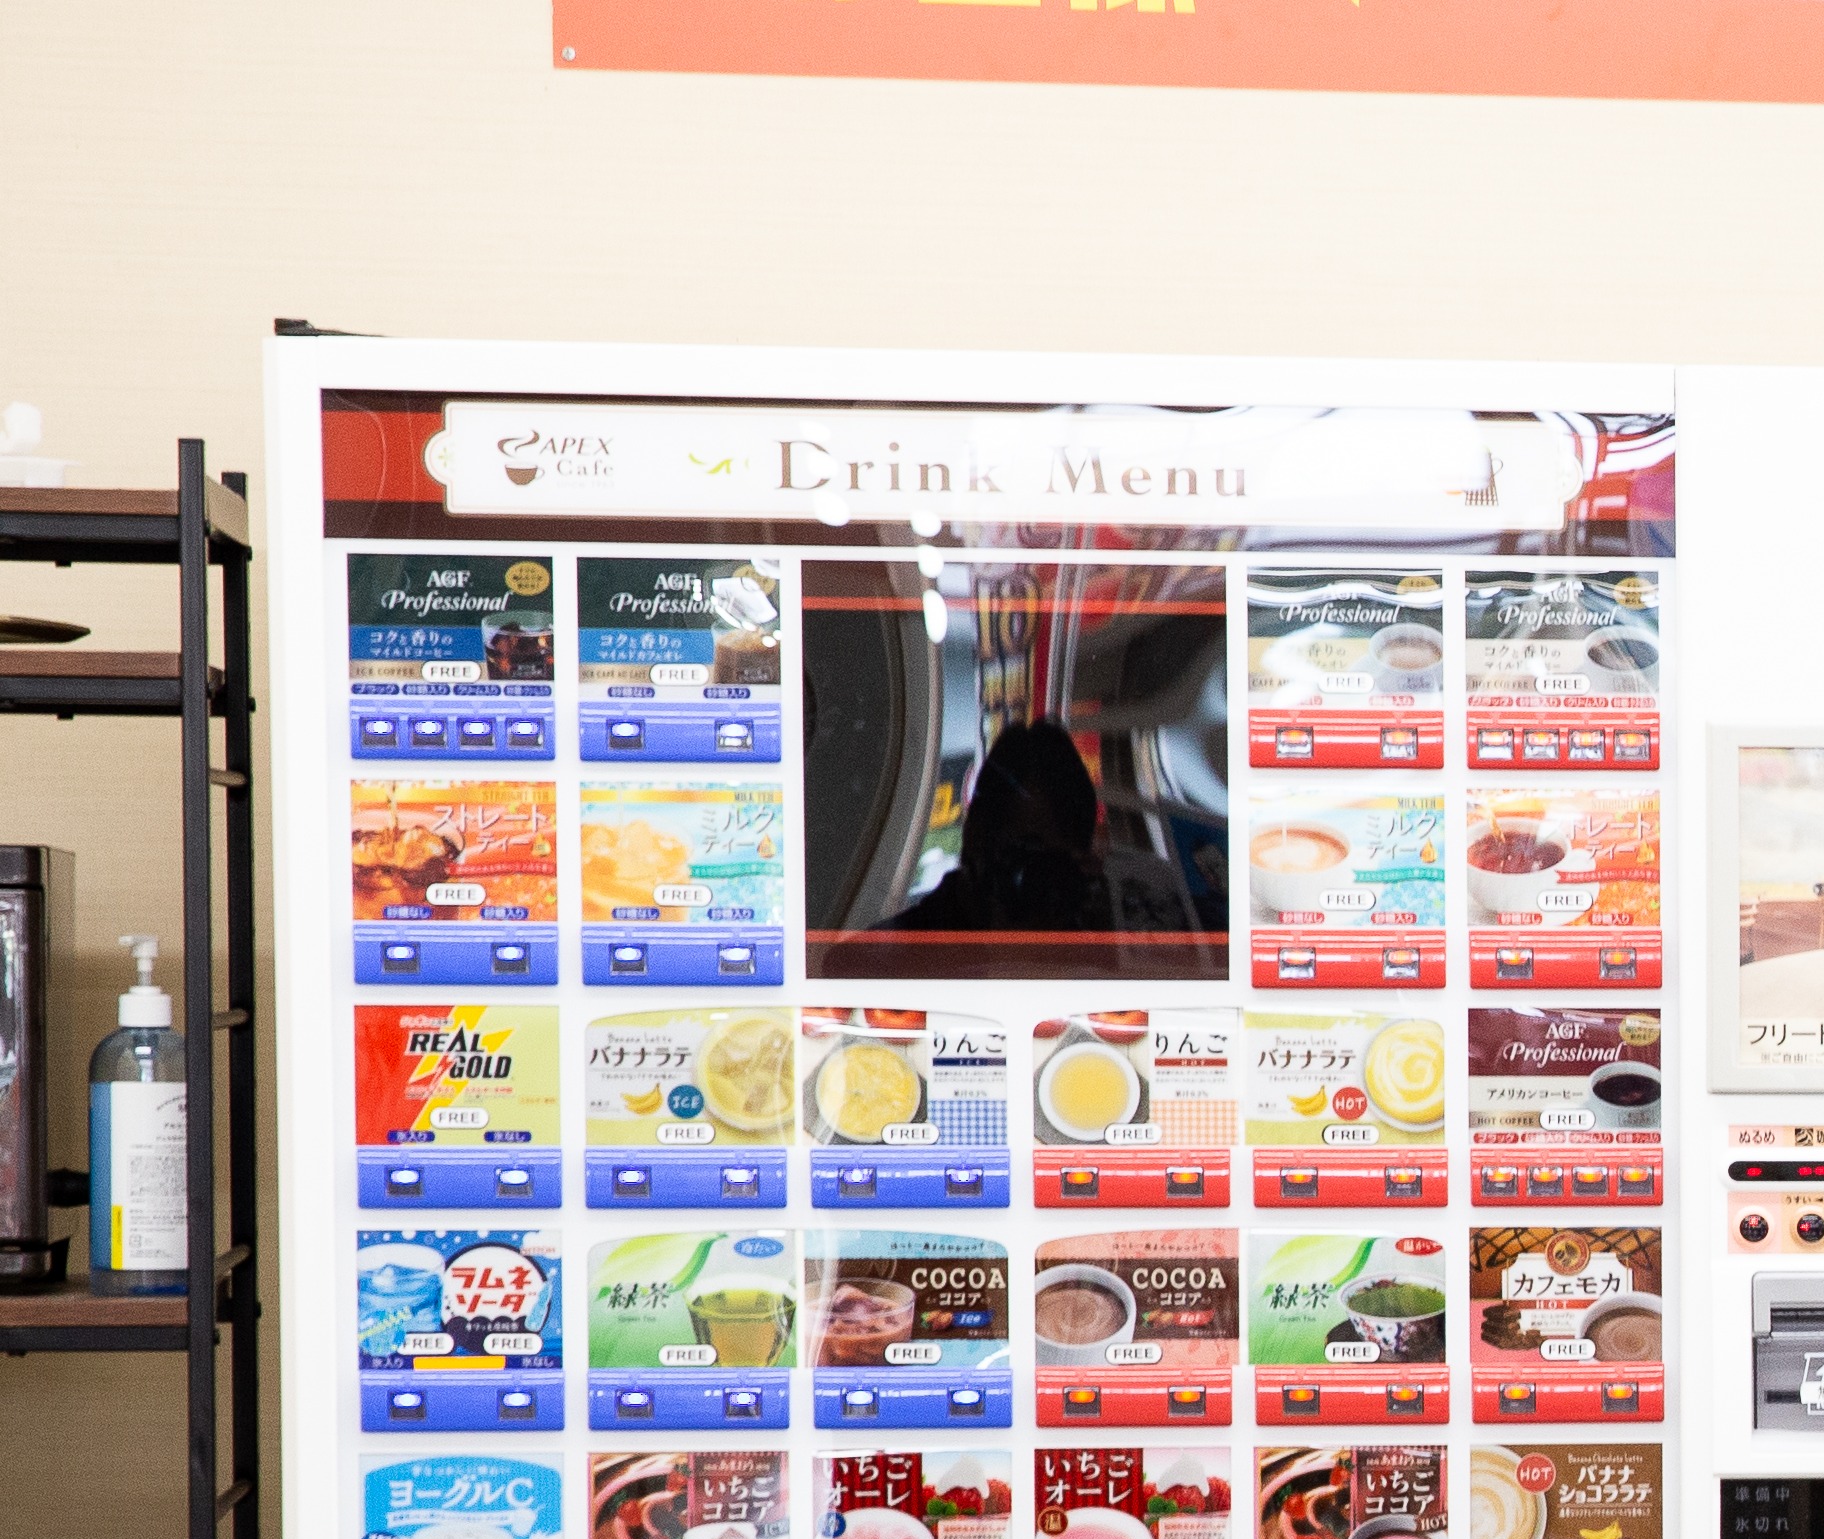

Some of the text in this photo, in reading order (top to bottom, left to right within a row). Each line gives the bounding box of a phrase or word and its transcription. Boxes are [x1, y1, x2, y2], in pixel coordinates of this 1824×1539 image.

[1046, 444, 1247, 497] Menu
[427, 570, 470, 589] AGF
[382, 589, 511, 615] Professional
[430, 665, 472, 679] FREE
[1326, 677, 1367, 689] FREE
[1545, 894, 1585, 907] FREE
[408, 1025, 486, 1055] REAL
[1545, 1021, 1587, 1040] AGF
[1154, 1031, 1230, 1055] りんご
[1503, 1040, 1622, 1068] Professional
[450, 1054, 513, 1080] GOLD
[589, 1046, 693, 1068] バナナラテ
[1257, 1048, 1357, 1069] バナナラテ
[1335, 1097, 1365, 1111] HOT
[1739, 1129, 1776, 1145] ぬるめ
[451, 1266, 533, 1290] ラムネ
[911, 1267, 1007, 1291] COCOA
[1131, 1267, 1227, 1291] COCOA
[1513, 1272, 1621, 1298] カフェモカ
[456, 1291, 538, 1314] ソーダ
[608, 1282, 671, 1312] 緑茶
[1270, 1282, 1329, 1311] 緑茶
[492, 1337, 534, 1350] FREE
[1043, 1452, 1134, 1480] いちご
[1520, 1467, 1552, 1482] HOT
[1578, 1465, 1635, 1484] バナナ
[701, 1476, 773, 1499] いちご
[1043, 1480, 1133, 1506] オーレ
[1365, 1470, 1435, 1494] いちご
[1366, 1495, 1436, 1515] ココア
